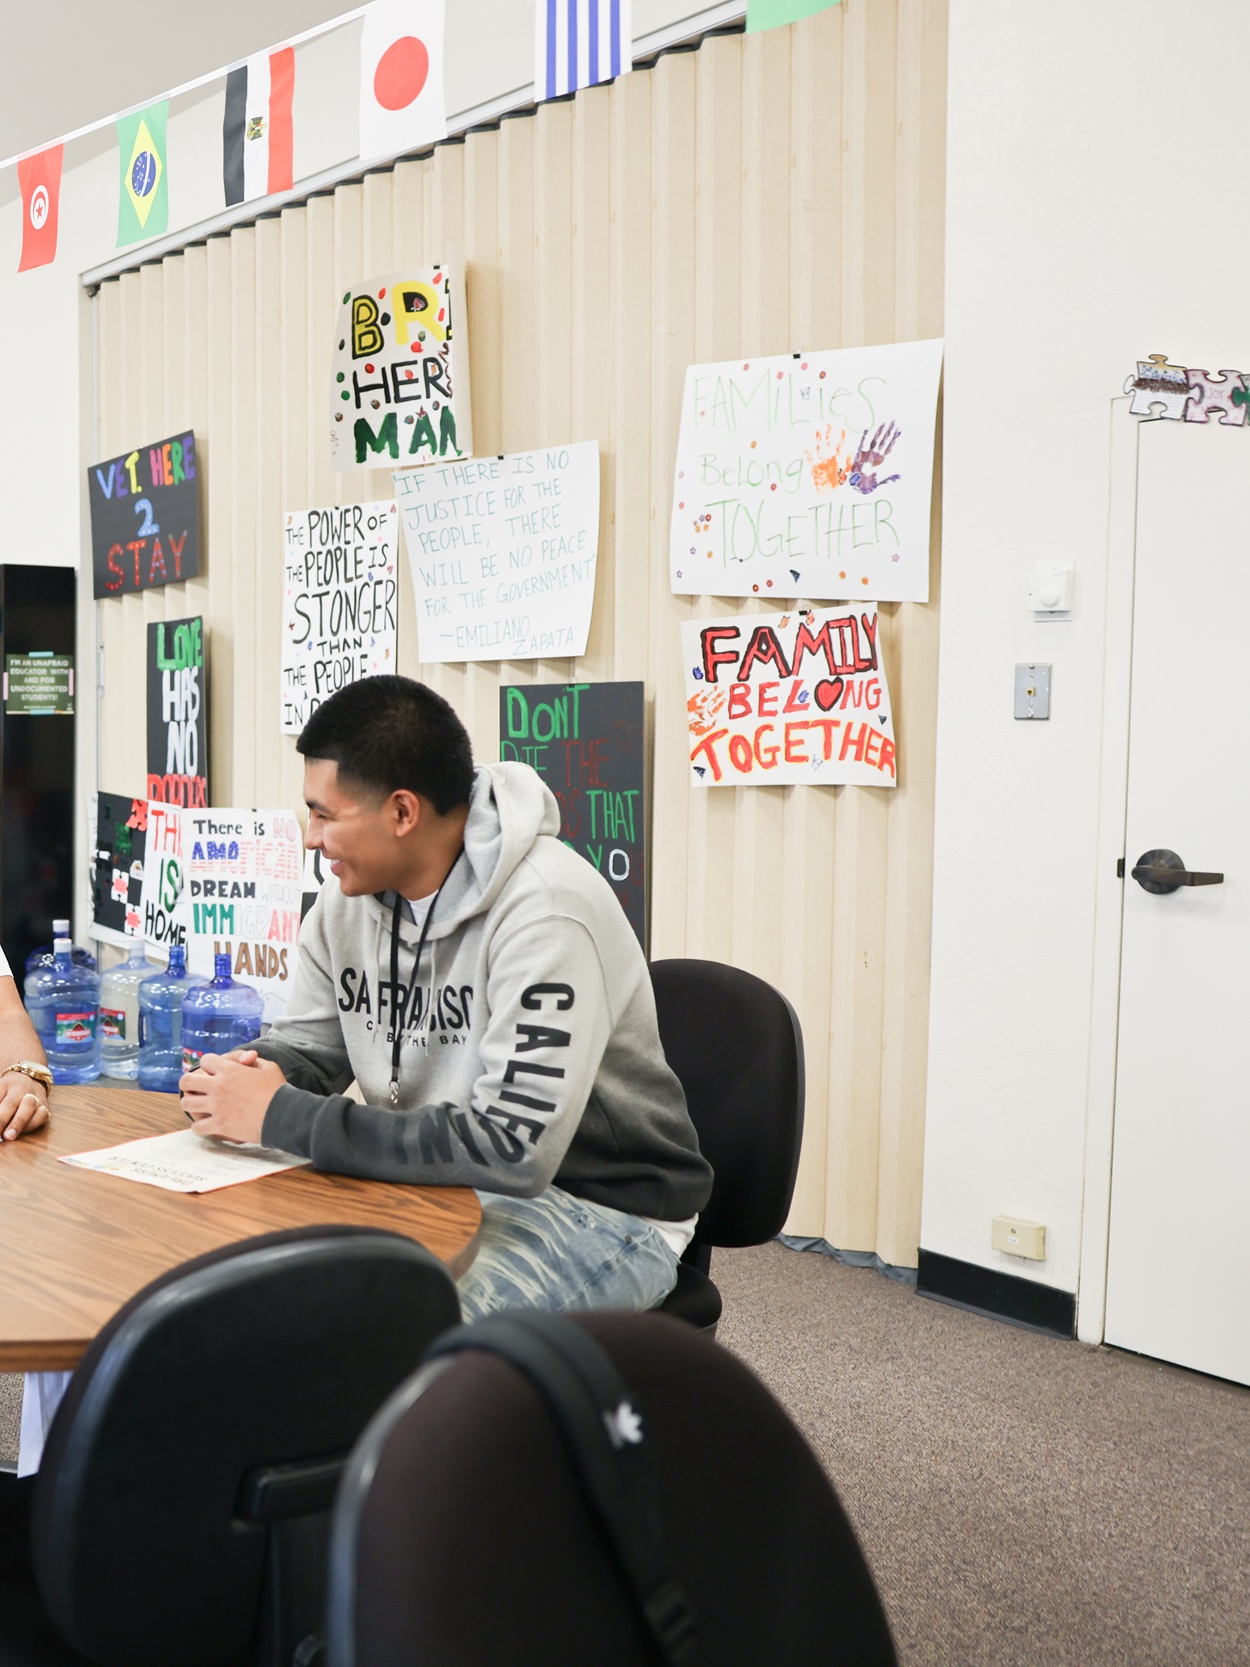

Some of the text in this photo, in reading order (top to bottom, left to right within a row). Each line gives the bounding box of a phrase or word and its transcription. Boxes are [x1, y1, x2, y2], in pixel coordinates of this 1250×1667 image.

[149, 436, 196, 486] HERE
[435, 462, 500, 488] THERE
[512, 456, 535, 474] IS
[546, 450, 570, 470] NO
[134, 498, 160, 537] 2
[286, 505, 388, 548] THE POWER OF
[405, 477, 562, 531] JUSTICE FOR THE
[505, 503, 562, 538] THERE
[419, 530, 587, 588] WILL BE NO PEACE
[704, 499, 901, 570] TOGETHER
[105, 530, 188, 591] STAY
[286, 543, 389, 588] THE PEOPLE IS
[292, 579, 396, 645] STONGER
[424, 596, 452, 617] FOR
[458, 589, 487, 610] THE
[157, 618, 203, 671] LOVE
[317, 636, 363, 656] THAN
[513, 626, 575, 656] ZAPATA
[700, 612, 878, 683] FAMILY
[162, 666, 200, 723] HAS
[284, 665, 307, 687] THE
[284, 703, 303, 725] IN
[166, 720, 198, 777] NO
[561, 738, 611, 788] THE
[690, 719, 896, 782] TOGETHER
[193, 817, 297, 841] There is NO
[586, 789, 639, 843] THAT
[159, 857, 180, 914] IS
[190, 880, 256, 899] DREAM
[439, 1034, 467, 1046] BAY
